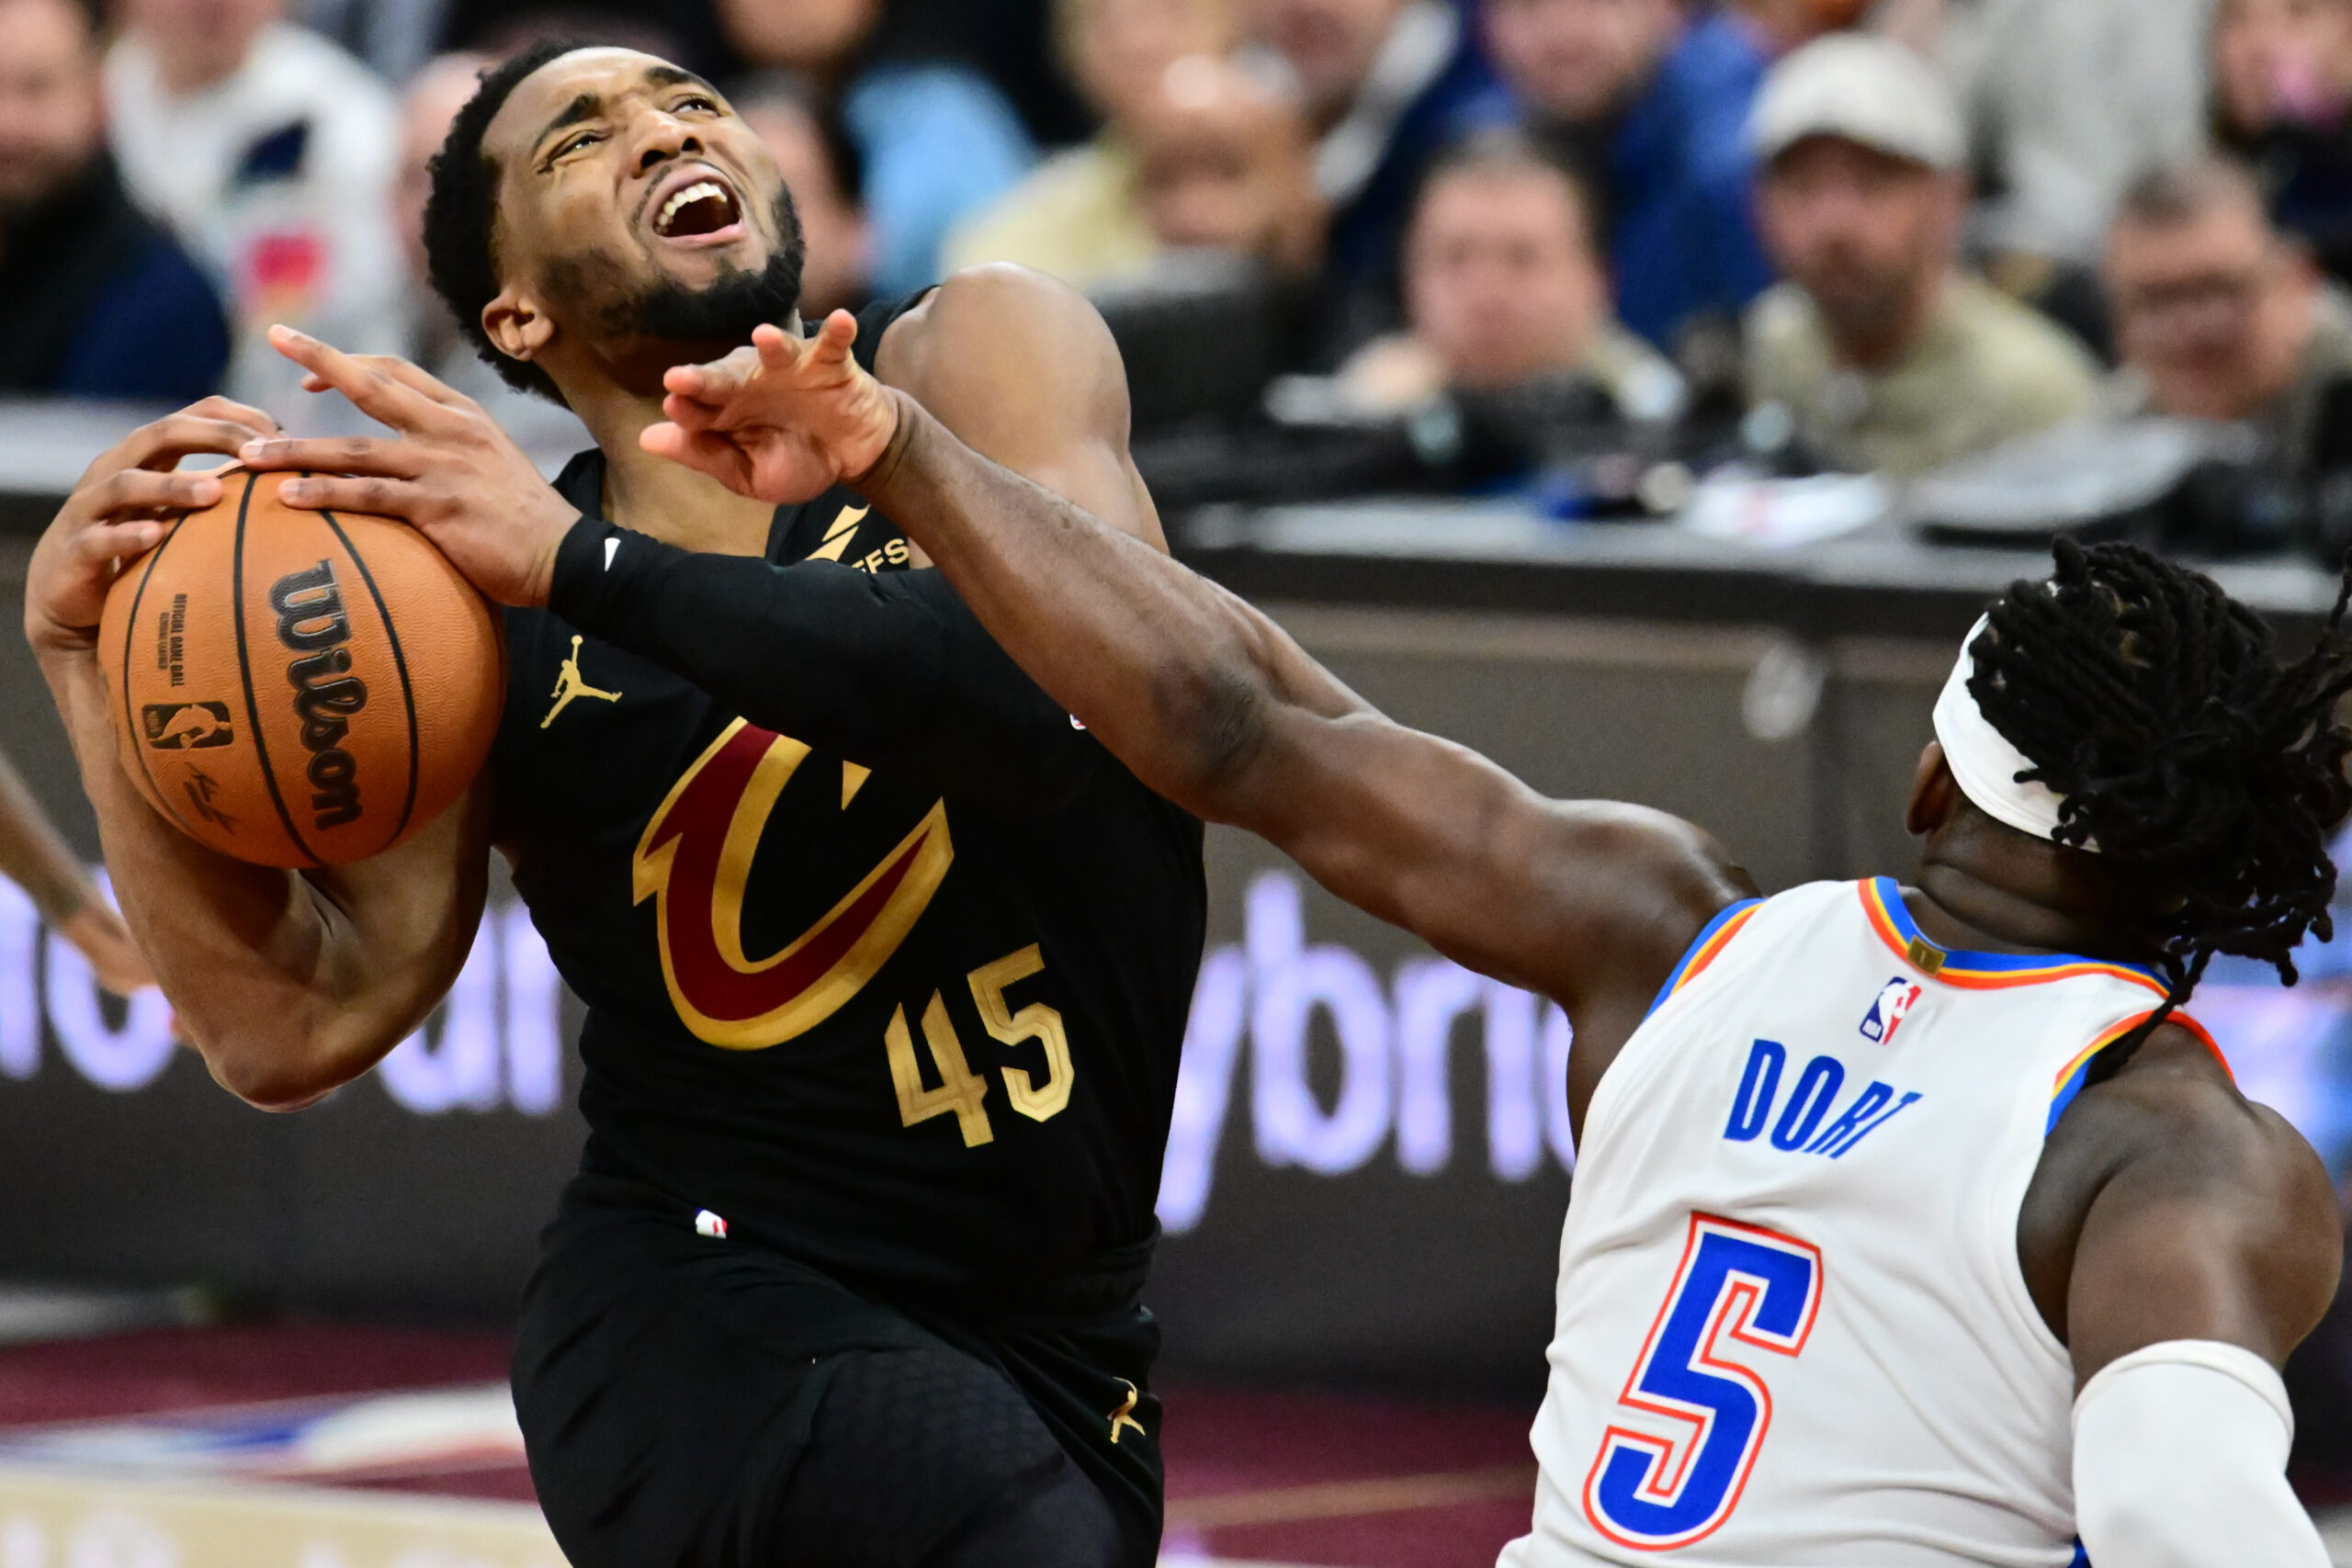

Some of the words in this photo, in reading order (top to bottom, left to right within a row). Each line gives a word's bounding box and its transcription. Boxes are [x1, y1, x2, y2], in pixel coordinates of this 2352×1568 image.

[170, 636, 184, 663] GAME
[170, 664, 185, 687] BALL
[268, 558, 367, 831] Wilson
[884, 942, 1075, 1148] 45
[1155, 868, 1576, 1234] ybri
[1723, 1038, 1924, 1160] DORT
[1582, 1211, 1824, 1551] 5
